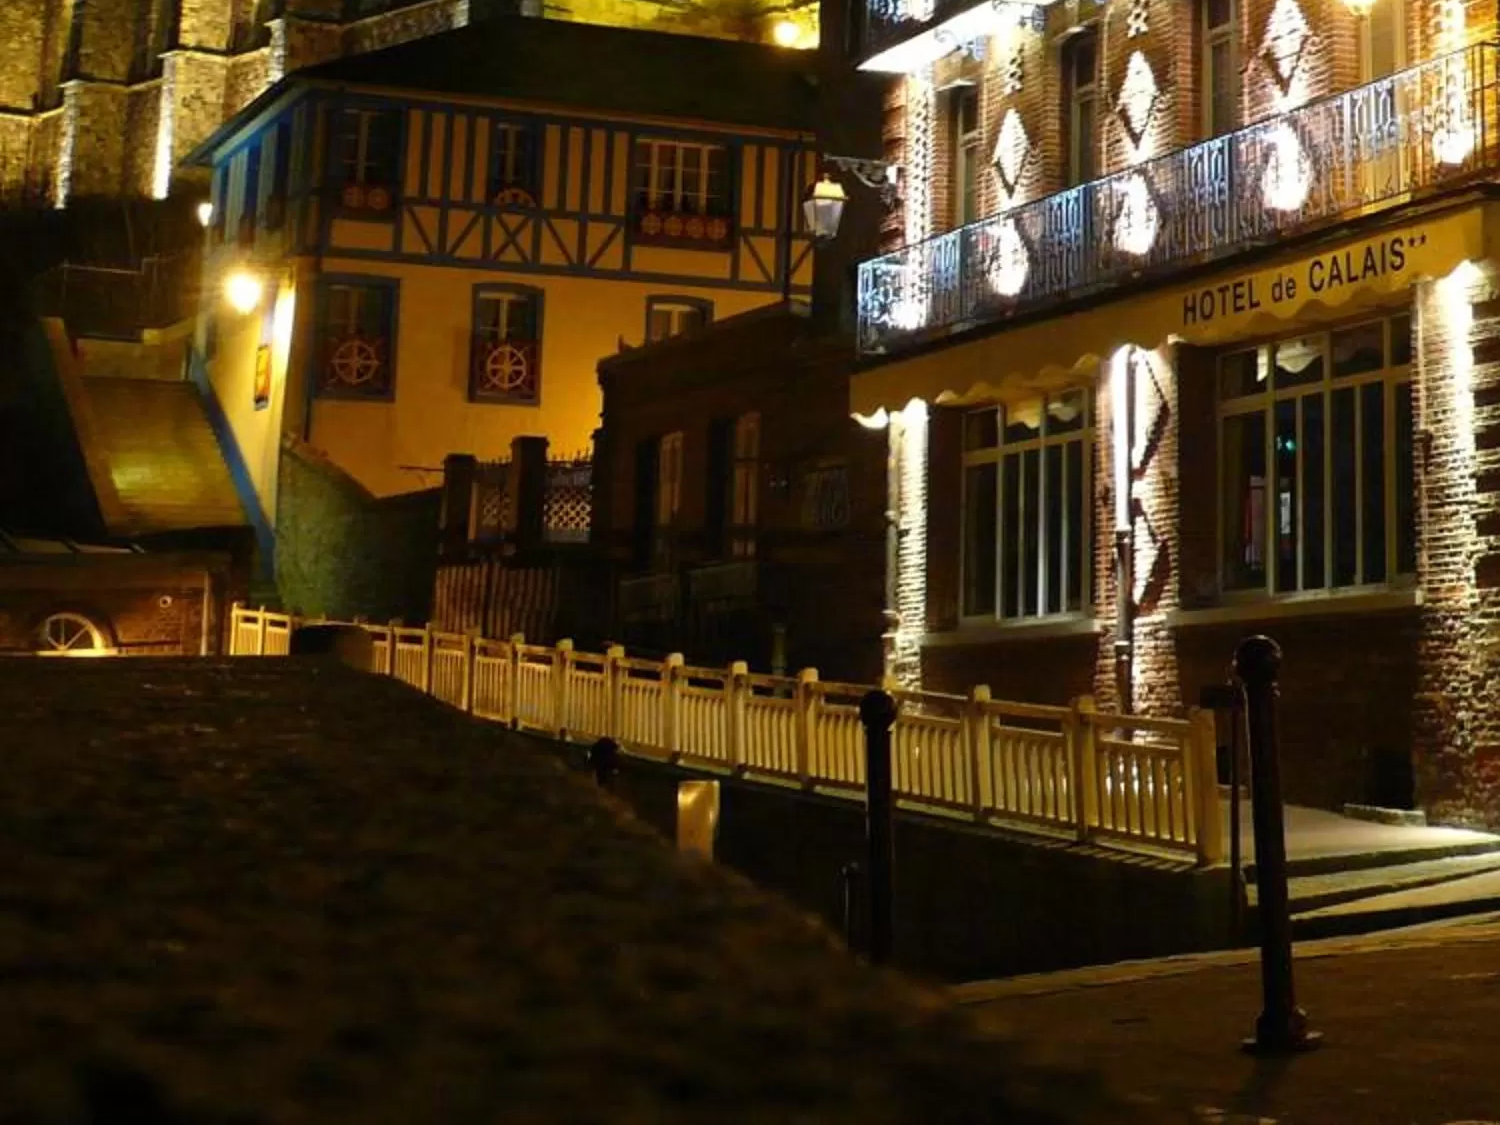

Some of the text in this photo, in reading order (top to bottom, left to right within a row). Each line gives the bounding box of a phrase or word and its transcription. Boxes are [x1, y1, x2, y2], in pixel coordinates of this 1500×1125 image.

[1183, 239, 1406, 325] HOTEL de CALAIS
